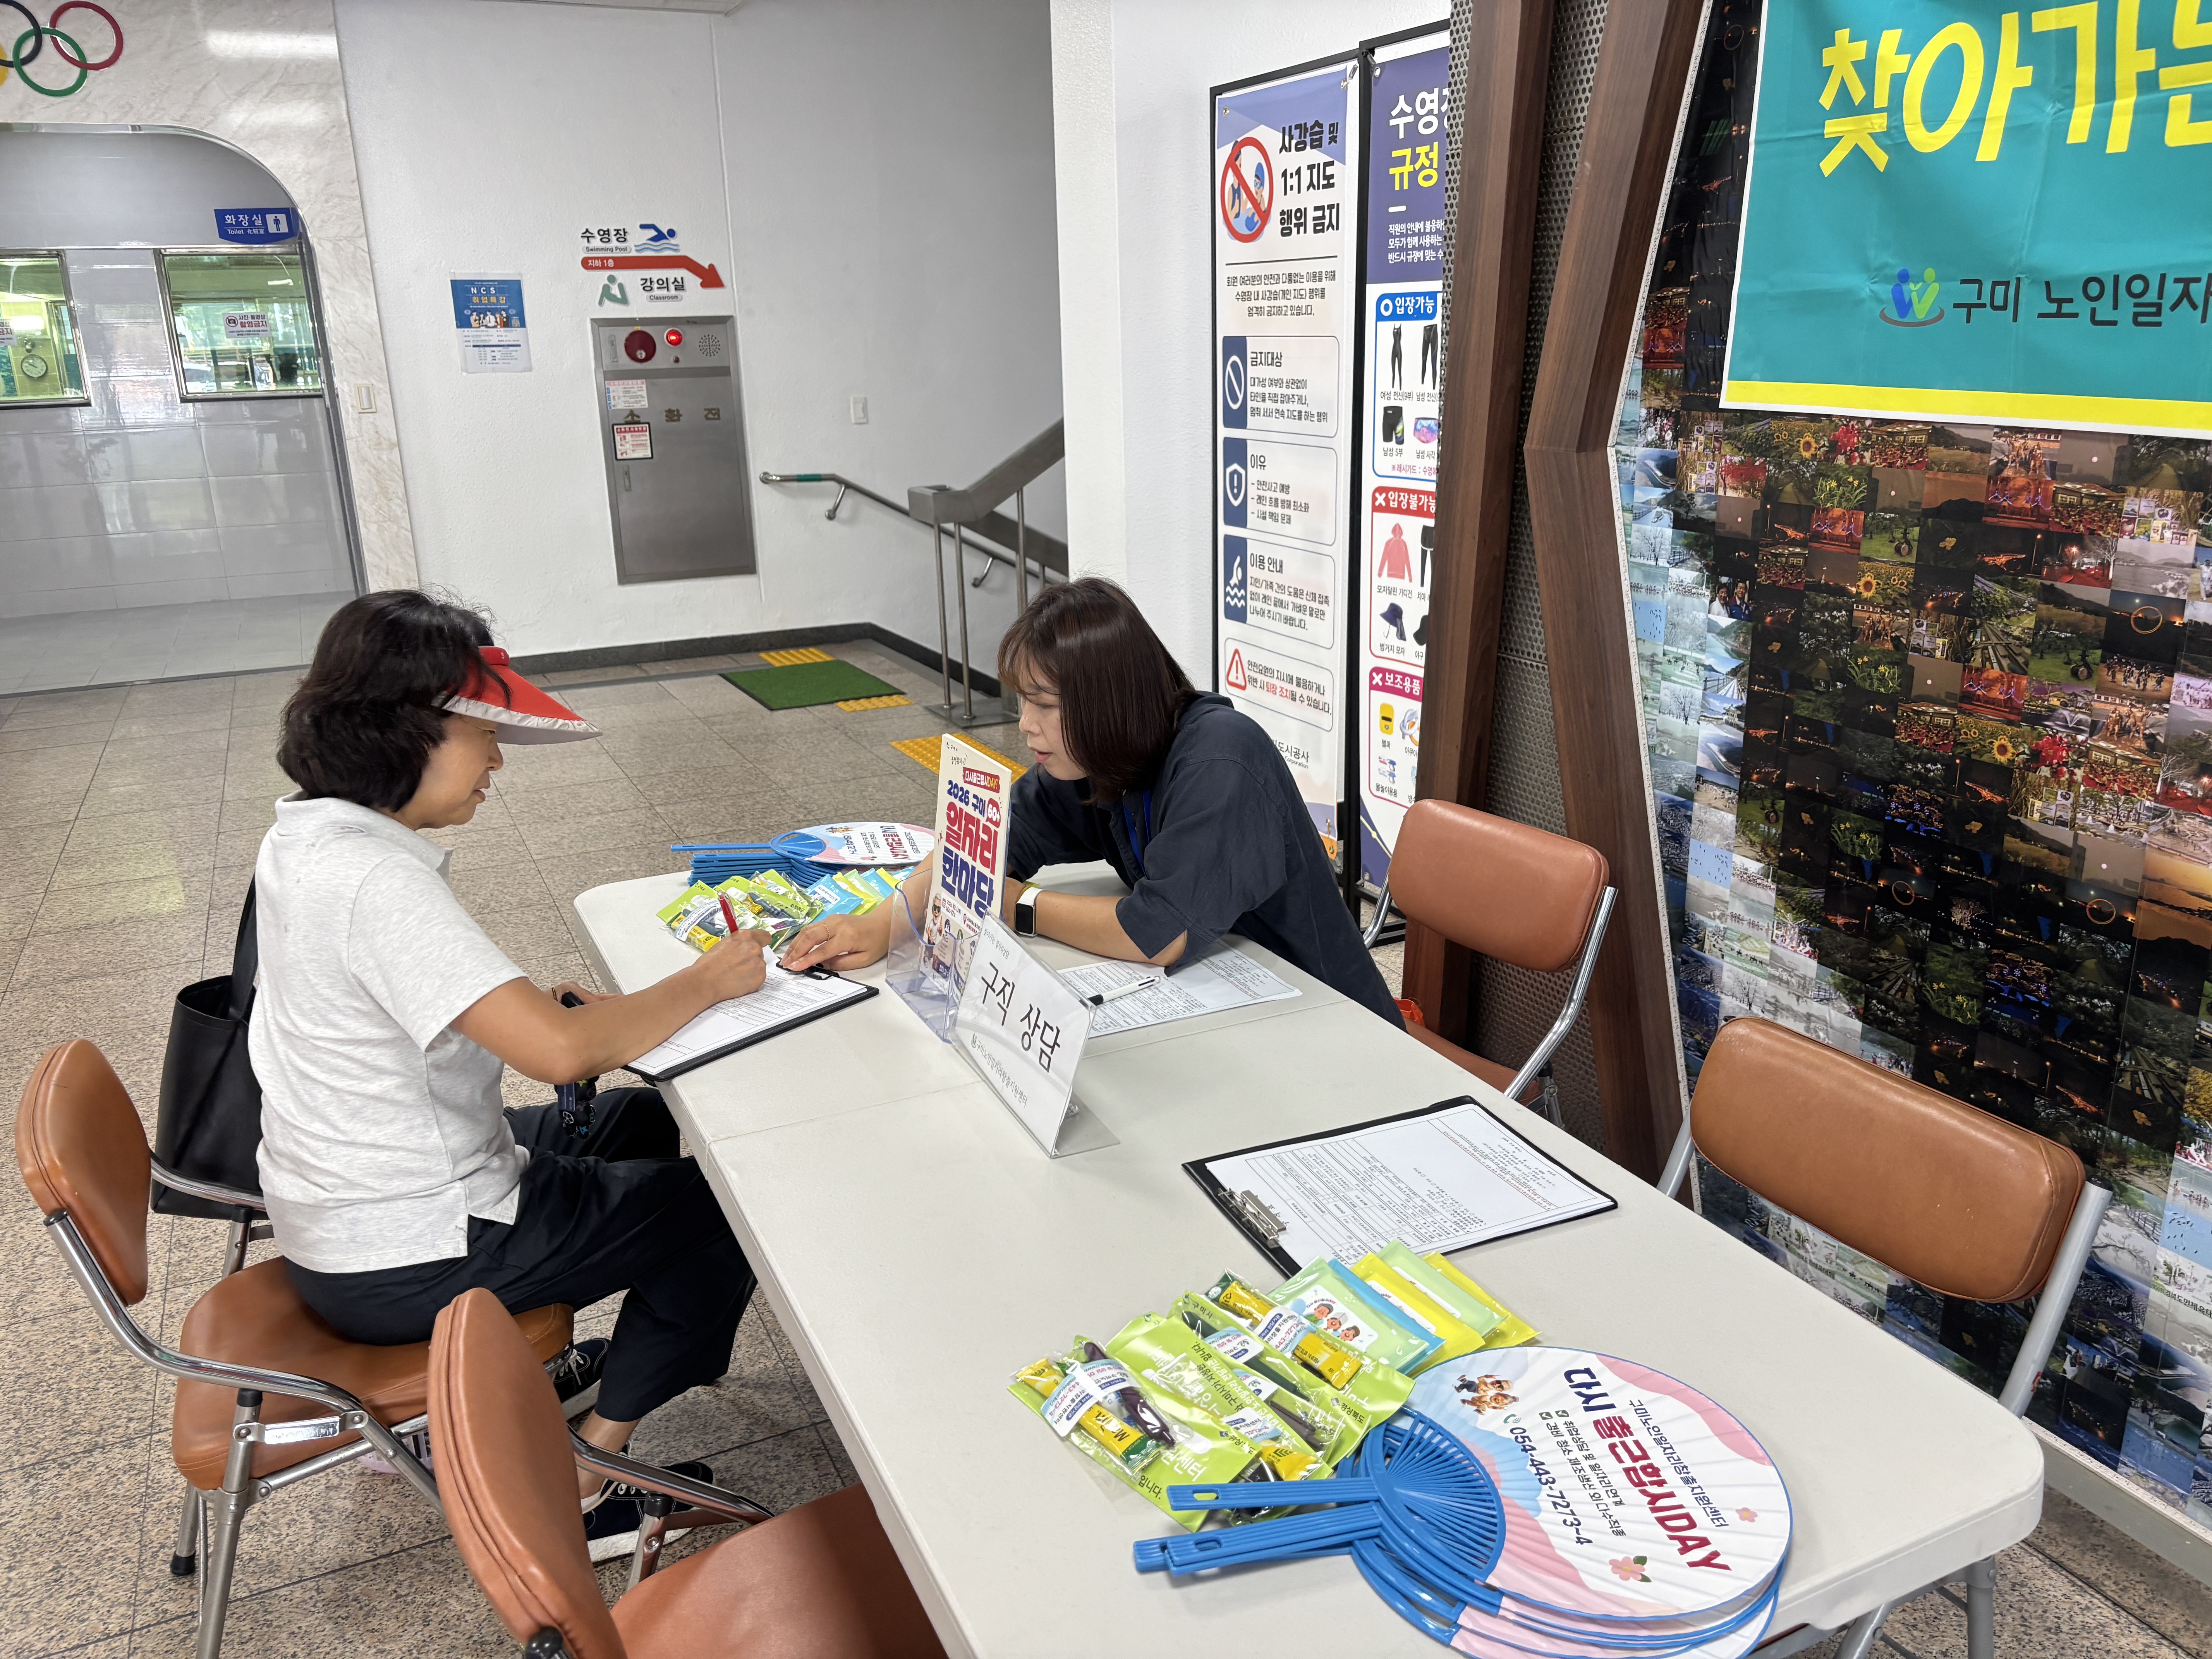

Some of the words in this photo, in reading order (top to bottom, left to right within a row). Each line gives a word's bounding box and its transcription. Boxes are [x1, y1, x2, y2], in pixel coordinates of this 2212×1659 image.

[1279, 120, 1324, 155] 사강습
[1328, 122, 1339, 146] 및
[1389, 141, 1438, 191] 규정
[1281, 166, 1301, 196] 1:1
[1307, 160, 1335, 192] 지도
[224, 214, 263, 226] 화장실
[1279, 207, 1307, 237] 행위
[1312, 203, 1340, 234] 금지
[1389, 223, 1406, 235] 직원의
[1407, 222, 1424, 234] 안내에
[581, 228, 628, 243] 수영장
[1388, 237, 1406, 249] 모두가
[1407, 236, 1418, 248] 함께
[1419, 235, 1442, 247] 사용하는
[604, 259, 614, 267] 1층
[1388, 252, 1406, 263] 반드시
[1407, 250, 1424, 263] 규정에
[1425, 249, 1436, 261] 맞는
[640, 277, 685, 292] 강의실
[1227, 276, 1238, 287] 회원
[1240, 275, 1262, 286] 여러분의
[1264, 273, 1280, 285] 안전과
[1282, 272, 1305, 284] 다툼없는
[1306, 271, 1323, 283] 이용을
[1325, 270, 1336, 282] 위해
[1235, 291, 1252, 302] 수영장
[1254, 290, 1259, 301] 내
[1261, 289, 1291, 301] 사강습(개인
[1293, 289, 1307, 300] 지도)
[1309, 288, 1325, 299] 행위를
[1953, 276, 2021, 324] 구미
[1248, 306, 1265, 317] 엄격히
[1267, 305, 1288, 316] 금지하고
[1290, 305, 1314, 316] 있습니다.
[1395, 296, 1434, 314] 입장가능
[1250, 351, 1283, 367] 금지대상
[1250, 377, 1267, 388] 대가성
[1268, 378, 1284, 388] 여부와
[1285, 379, 1307, 389] 상관없이
[1250, 392, 1266, 403] 타인을
[1268, 393, 1278, 403] 직접
[1280, 393, 1309, 407] 잡아주거나,
[1380, 391, 1391, 400] 여성
[1393, 391, 1413, 402] 전신(9부)
[1416, 392, 1425, 402] 남성
[1250, 407, 1261, 417] 멈춰
[1262, 407, 1273, 418] 서서
[1274, 408, 1285, 419] 연속
[1286, 409, 1302, 421] 지도를
[1304, 410, 1315, 422] 하는
[1317, 412, 1328, 422] 행위
[1383, 447, 1393, 457] 남성
[1395, 448, 1403, 457] 5부
[1416, 450, 1425, 459] 남성
[1426, 450, 1435, 460] 사각
[1250, 454, 1266, 470] 이유
[1257, 480, 1278, 493] 안전사고
[1279, 483, 1290, 495] 예방
[1256, 495, 1267, 506] 레인
[1268, 497, 1278, 508] 흐름
[1280, 498, 1291, 509] 방해
[1293, 501, 1309, 513] 최소화
[1257, 510, 1267, 520] 시설
[1268, 512, 1279, 523] 책임
[1281, 513, 1291, 525] 문제
[1250, 553, 1265, 570] 이용
[1267, 557, 1283, 574] 안내
[1250, 576, 1274, 592] 지인/가족
[1275, 582, 1285, 594] 간의
[1287, 586, 1304, 599] 도움은
[1305, 590, 1316, 602] 신체
[1318, 594, 1329, 606] 접촉
[1377, 585, 1397, 596] 모자달린
[1399, 588, 1412, 599] 가디건
[1417, 591, 1426, 602] 치마
[1250, 590, 1260, 602] 없이
[1261, 593, 1272, 606] 레인
[1273, 598, 1289, 611] 끝에서
[1290, 601, 1307, 615] 가벼운
[1309, 606, 1325, 621] 말로만
[1250, 605, 1265, 618] 나누어
[1267, 610, 1282, 623] 주시기
[1283, 615, 1308, 630] 바랍니다.
[1380, 642, 1395, 654] 벙거지
[1396, 644, 1405, 656] 모자
[1247, 659, 1274, 678] 안전요원의
[1276, 670, 1293, 685] 지시에
[1295, 675, 1325, 696] 불응하거나
[1385, 672, 1420, 696] 보조용품
[1247, 675, 1257, 689] 위반
[1259, 679, 1264, 690] 시
[1266, 682, 1277, 695] 퇴장
[1279, 686, 1297, 702] 조치될
[1298, 694, 1305, 704] 수
[1307, 696, 1332, 715] 있습니다.
[1381, 739, 1391, 749] 헬퍼
[1376, 783, 1398, 798] 물놀이용품
[947, 780, 970, 806] 2026
[972, 794, 986, 817] 구미
[988, 804, 1000, 822] 60+
[945, 801, 998, 876] 일자리
[941, 845, 994, 919] 한마당
[981, 962, 1015, 1026] 구직
[1020, 1003, 1060, 1073] 상담
[977, 1040, 1027, 1108] 구미노인일자리창출지원센터
[1340, 1402, 1365, 1425] 경상북도
[1563, 1419, 1590, 1451] 취업상담
[1585, 1448, 1594, 1461] 및
[1564, 1367, 1617, 1413] 다시
[1593, 1415, 1732, 1572] 출근합시DAY
[1628, 1398, 1730, 1529] 구미노인일자리창출지원센터
[1546, 1421, 1565, 1439] 경비
[1556, 1440, 1573, 1456] 청소
[1567, 1456, 1598, 1491] 제조생산
[1588, 1490, 1600, 1504] 외
[1594, 1502, 1627, 1538] 다수직종
[1588, 1462, 1613, 1489] 일자리
[1510, 1427, 1594, 1547] 054-443-7273~4
[1604, 1488, 1626, 1509] 연계
